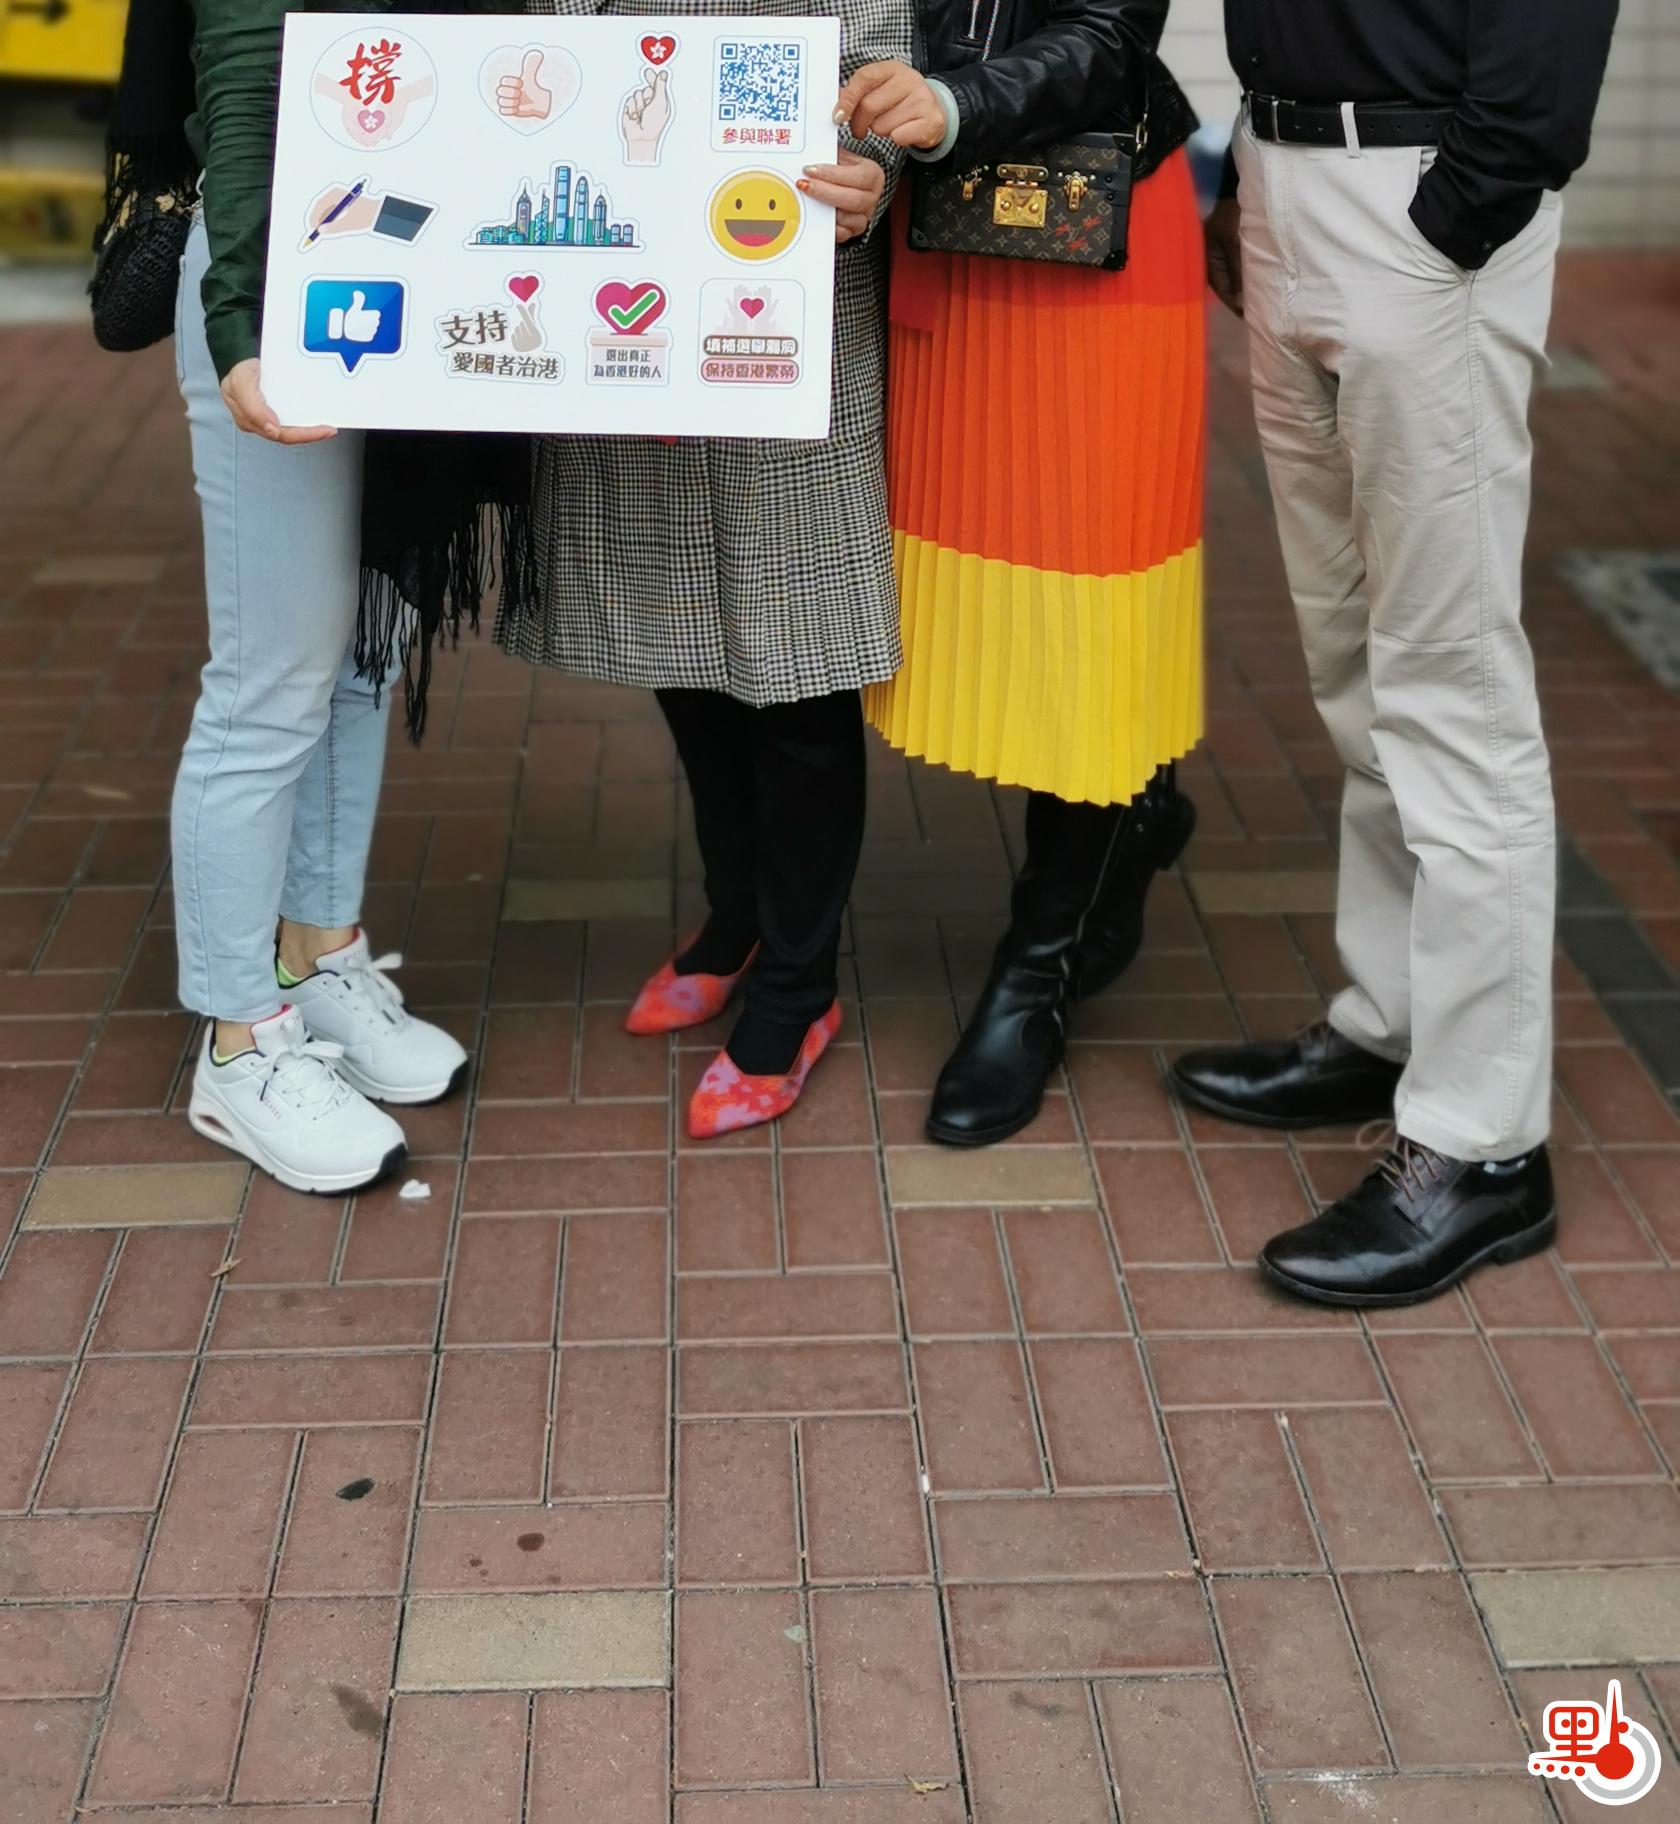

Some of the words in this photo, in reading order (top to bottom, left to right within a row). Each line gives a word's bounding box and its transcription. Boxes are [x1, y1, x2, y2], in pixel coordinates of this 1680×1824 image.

[339, 38, 402, 106] 撐
[722, 127, 791, 145] 參與聯署
[440, 310, 508, 349] 支持
[451, 352, 559, 379] 愛國者治港
[606, 349, 651, 362] 選出真正
